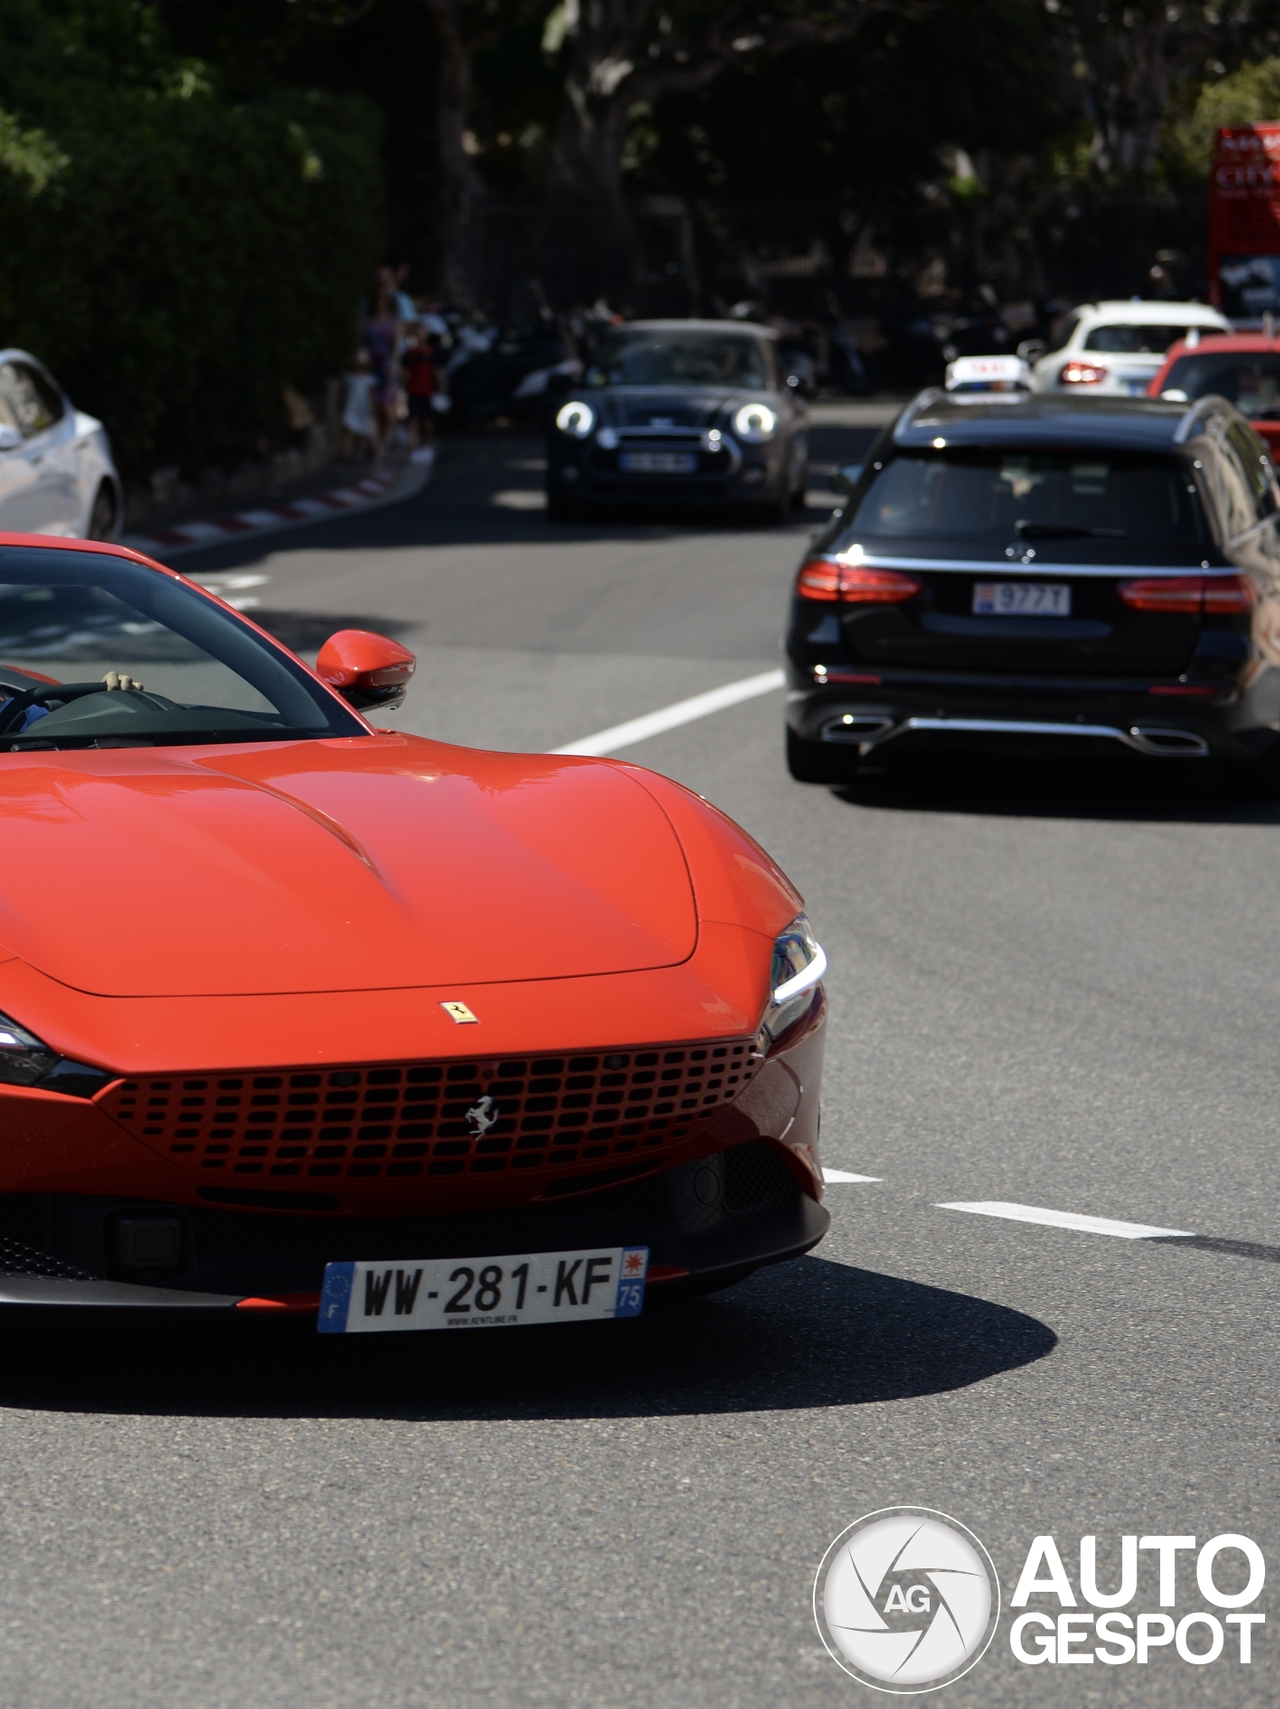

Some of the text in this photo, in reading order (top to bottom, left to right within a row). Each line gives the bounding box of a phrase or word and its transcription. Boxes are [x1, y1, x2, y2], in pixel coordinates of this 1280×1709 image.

[364, 1257, 612, 1316] WW-281-KF
[620, 1285, 640, 1306] 75
[326, 1304, 338, 1319] F
[447, 1315, 518, 1326] WWW.RENTLINE.FR
